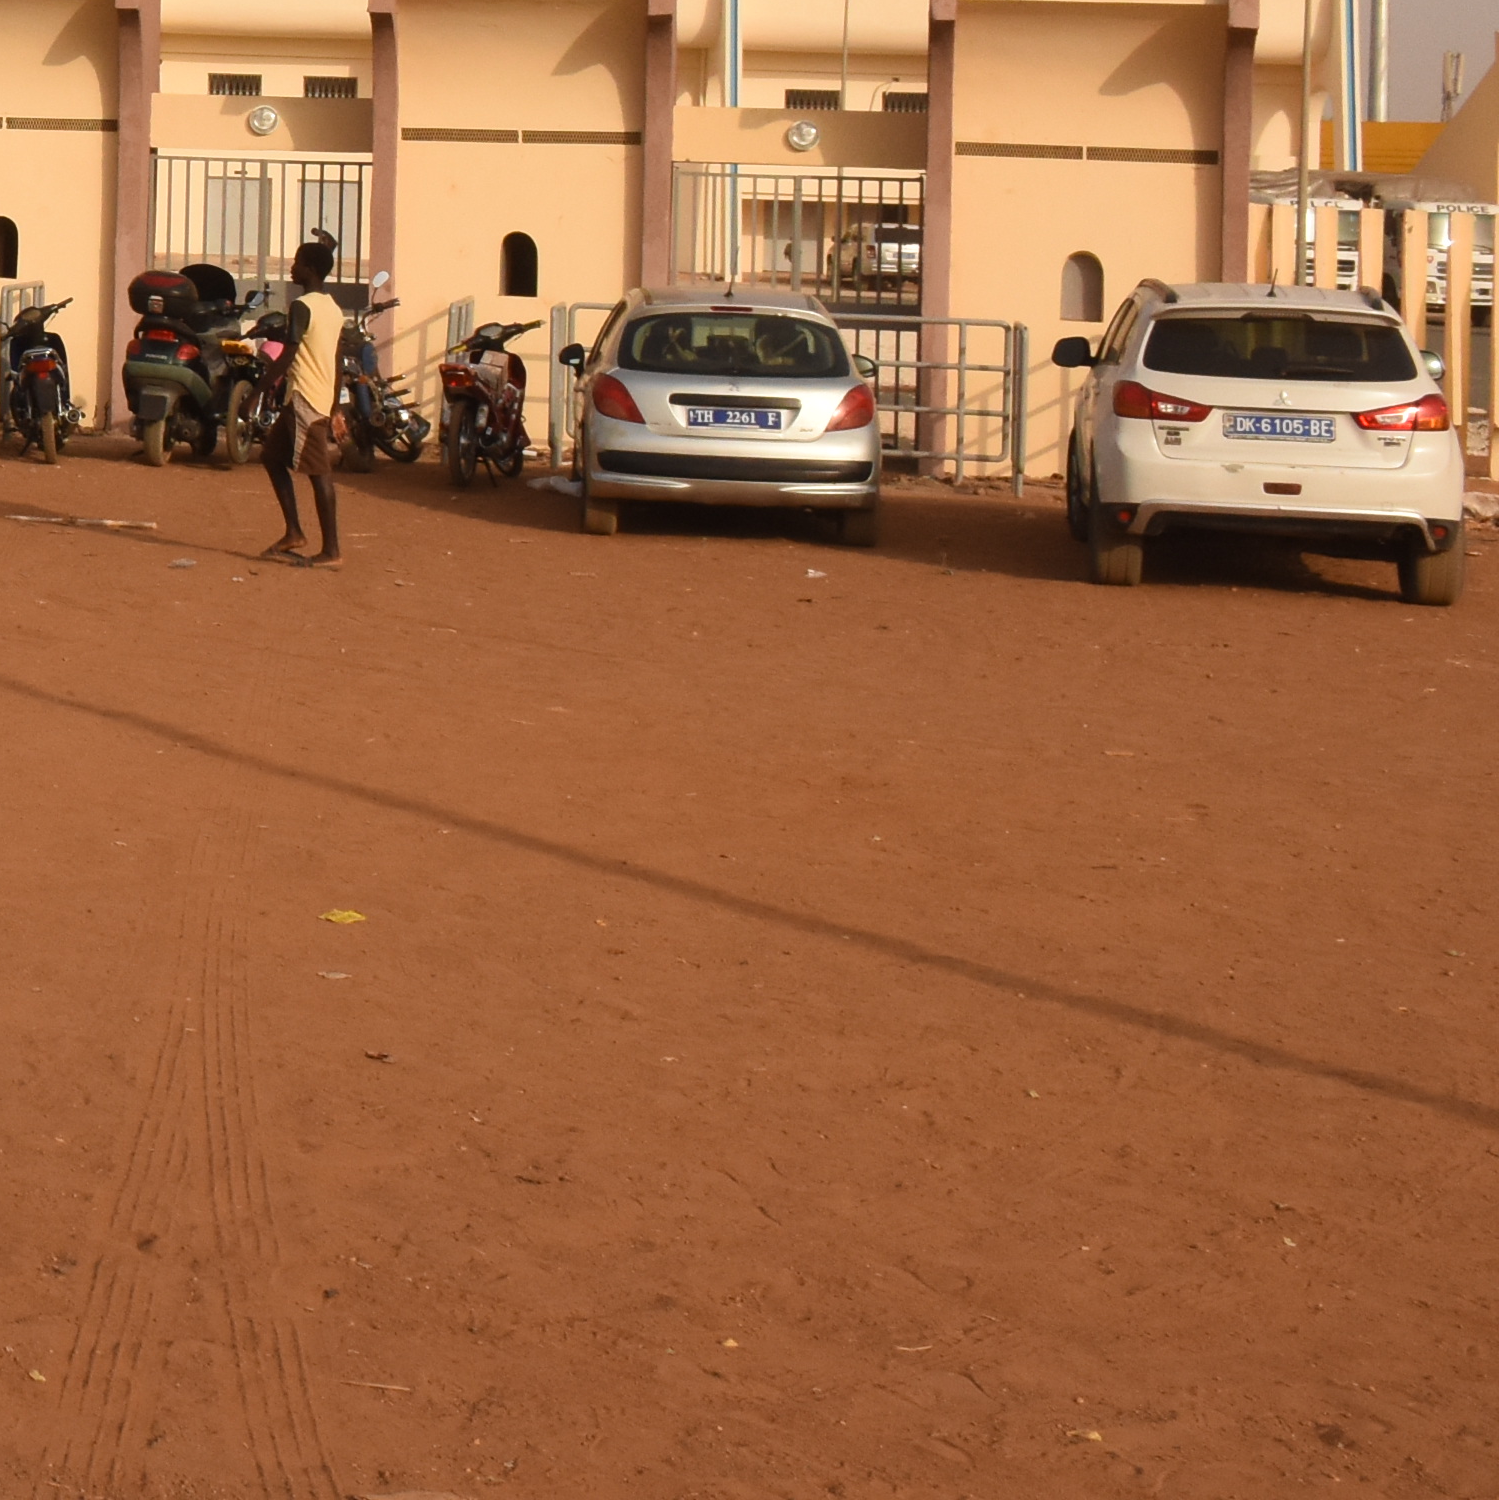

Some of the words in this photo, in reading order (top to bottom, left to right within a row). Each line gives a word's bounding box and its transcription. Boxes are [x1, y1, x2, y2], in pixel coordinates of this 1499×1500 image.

[1436, 203, 1490, 214] POLICE
[726, 411, 756, 424] 2261
[1236, 417, 1331, 437] DK-6105-BE
